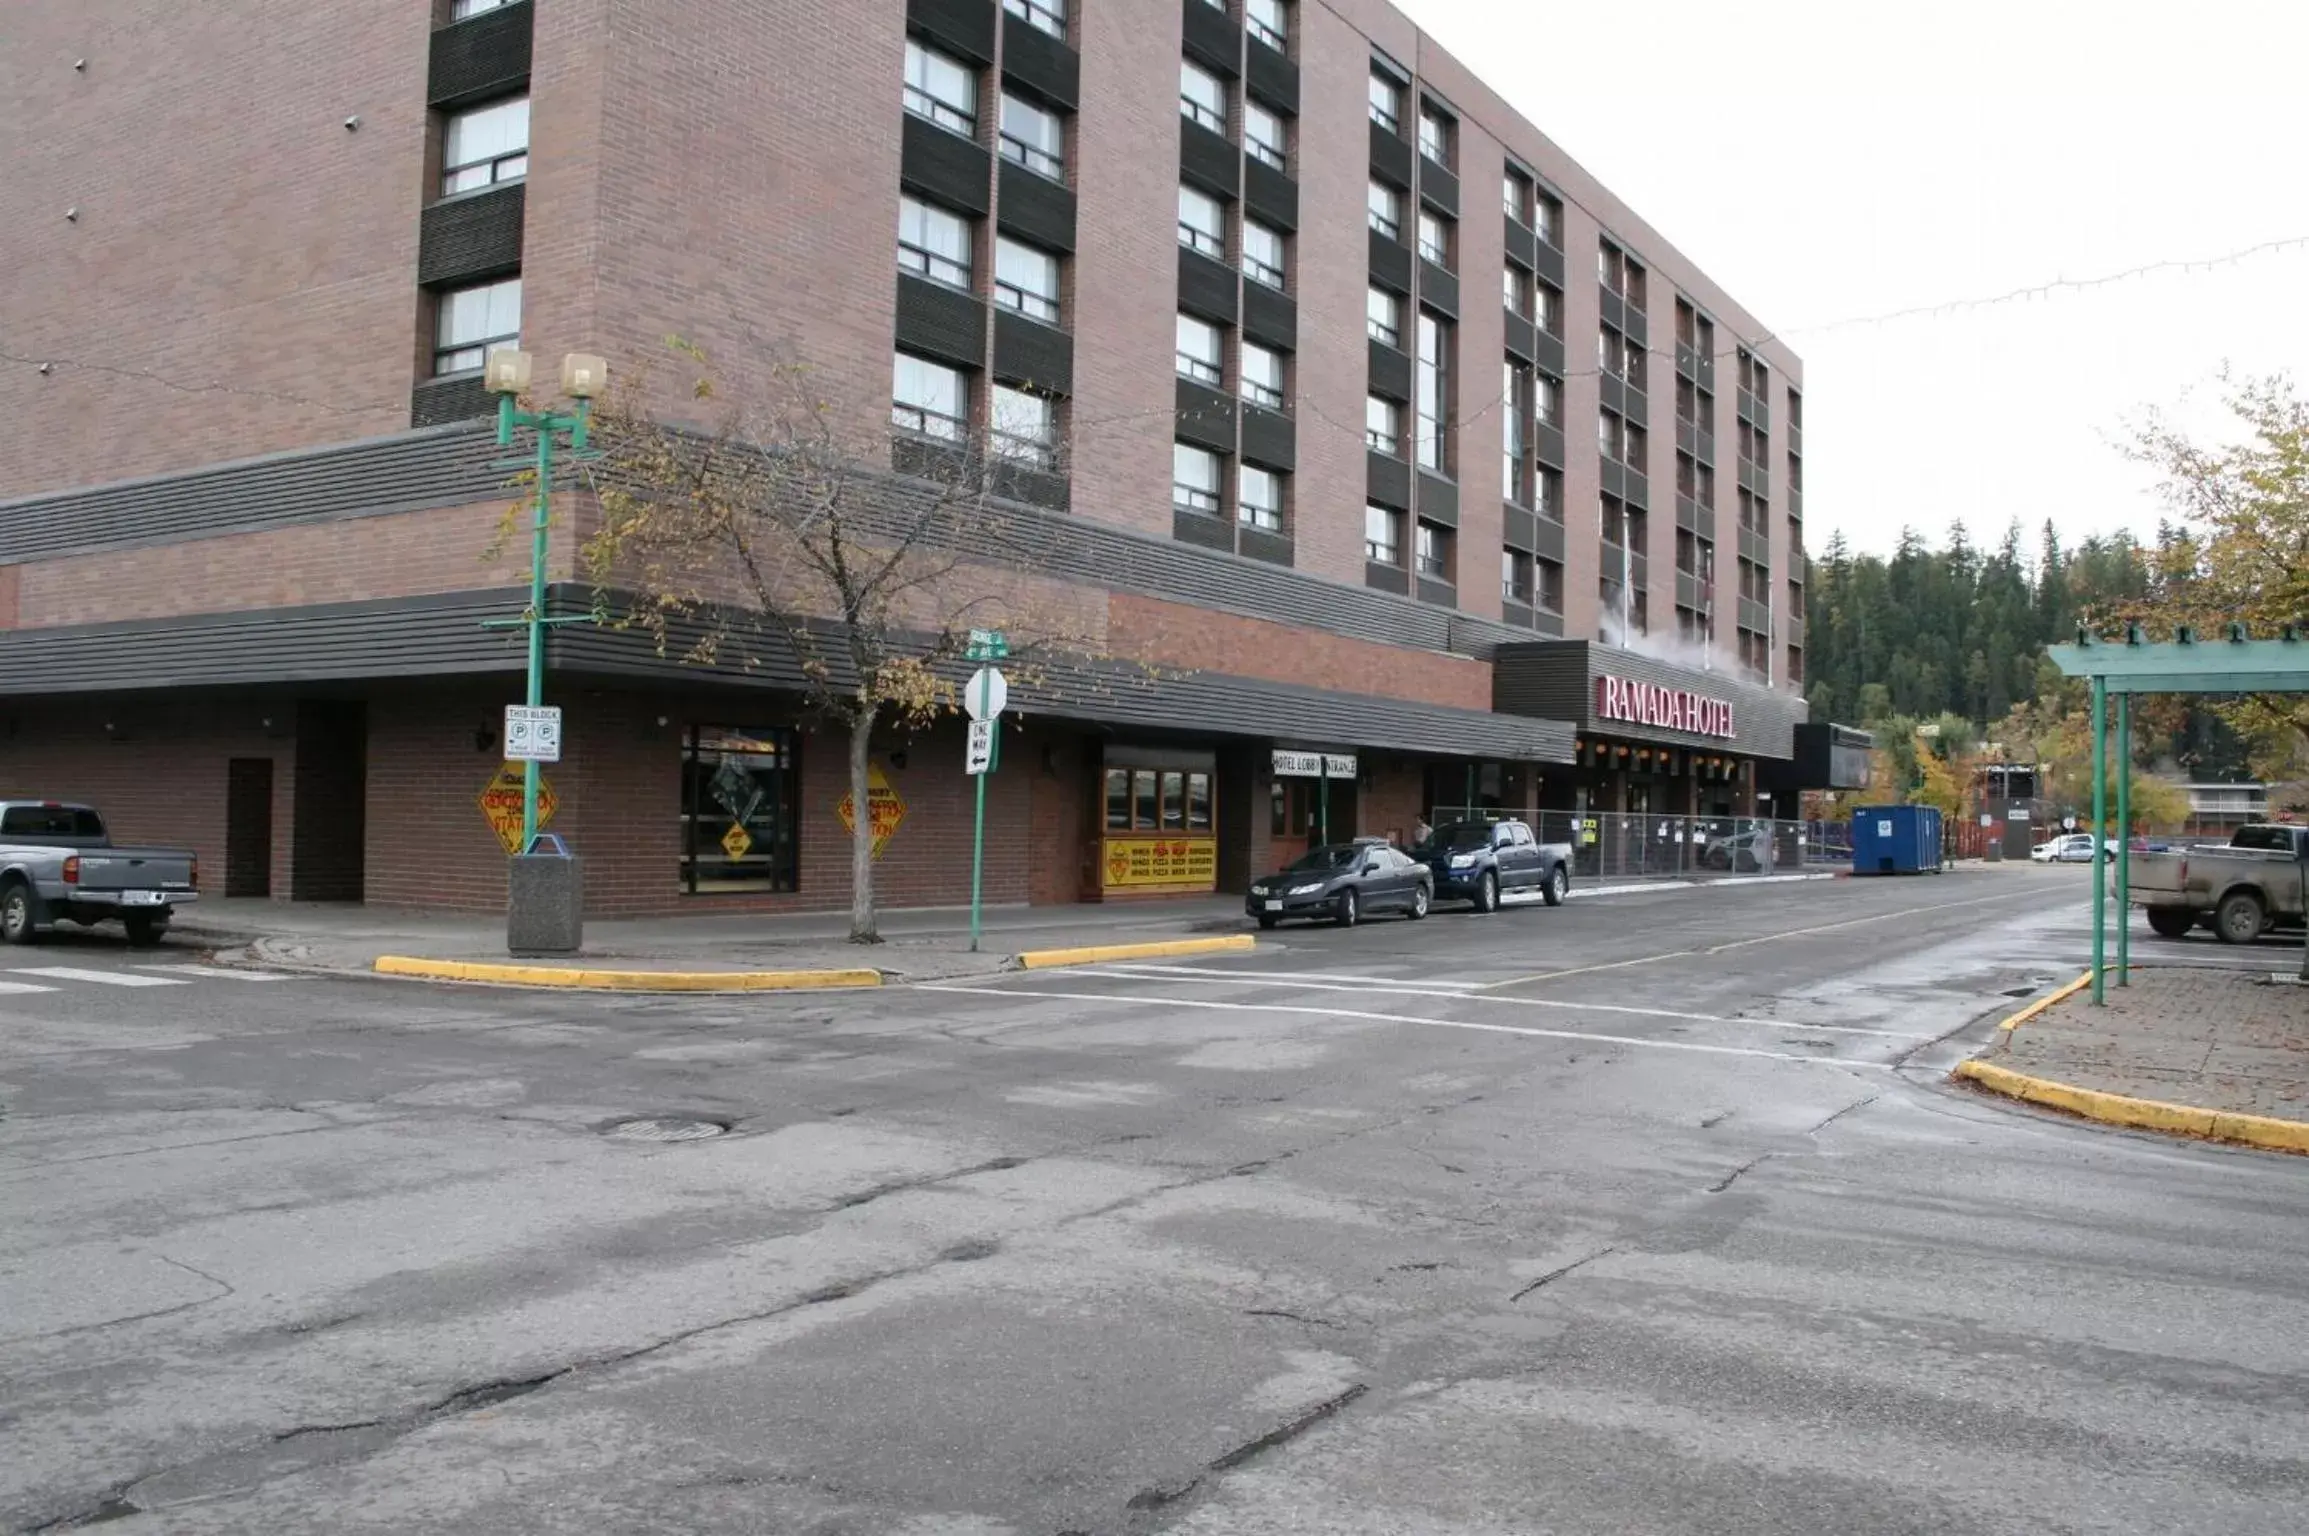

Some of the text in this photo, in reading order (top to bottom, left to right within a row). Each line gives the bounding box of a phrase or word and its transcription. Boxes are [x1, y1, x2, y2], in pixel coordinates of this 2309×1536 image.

[1604, 674, 1736, 738] RAMADA HOTEL
[509, 709, 557, 719] THIS BLOCK
[973, 723, 988, 737] ONE
[972, 738, 986, 751] WAY
[1273, 755, 1356, 774] HOTEL LOBBY NTRANCE
